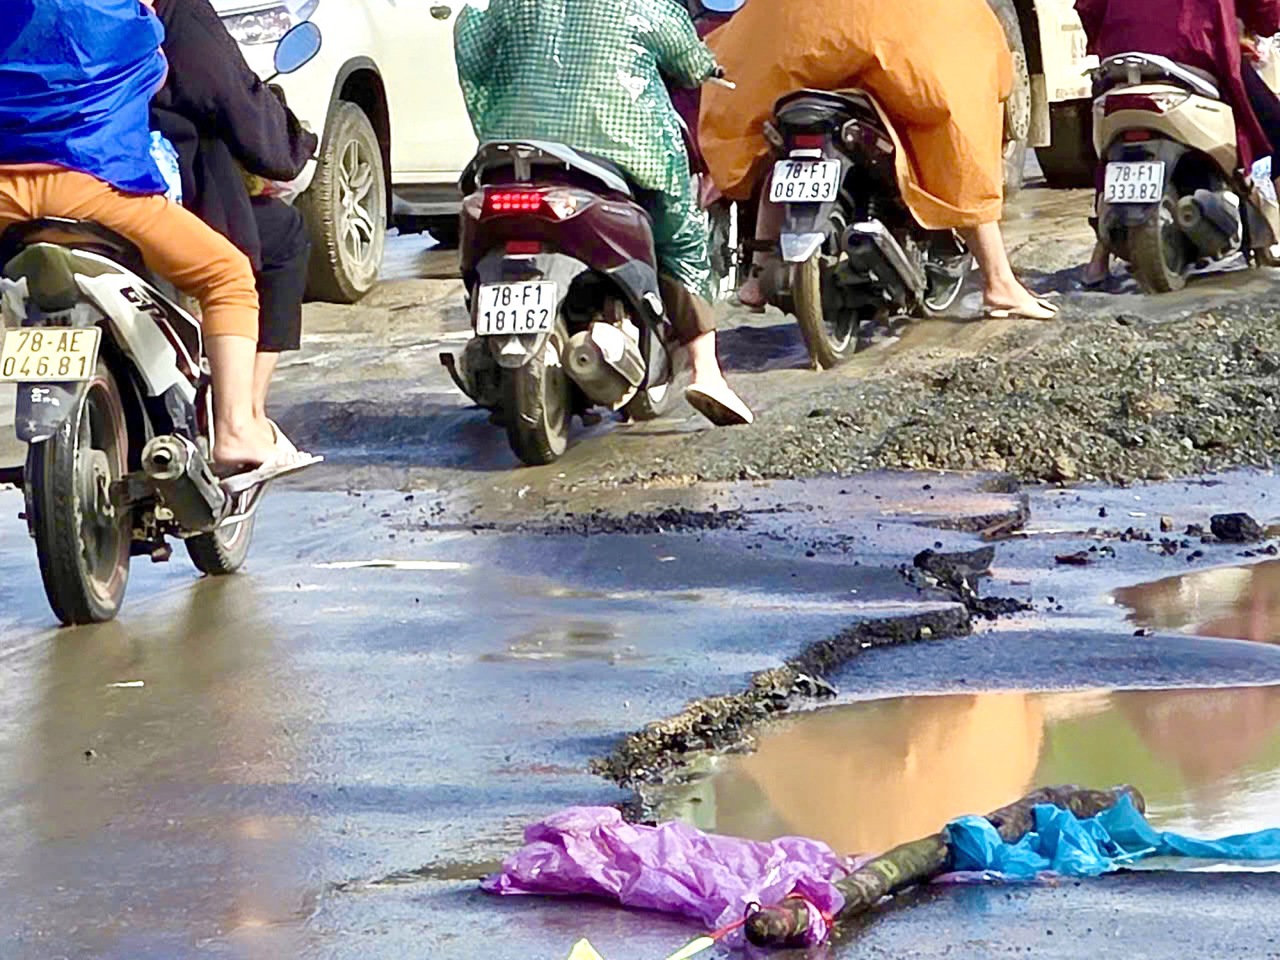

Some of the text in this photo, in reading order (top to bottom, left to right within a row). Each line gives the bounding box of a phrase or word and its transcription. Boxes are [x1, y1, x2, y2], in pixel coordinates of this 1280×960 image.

[774, 182, 831, 199] 087.93
[1109, 183, 1157, 200] 333.82
[484, 309, 549, 332] 181.62
[17, 331, 84, 353] 78-AE
[2, 356, 87, 378] 046.81
